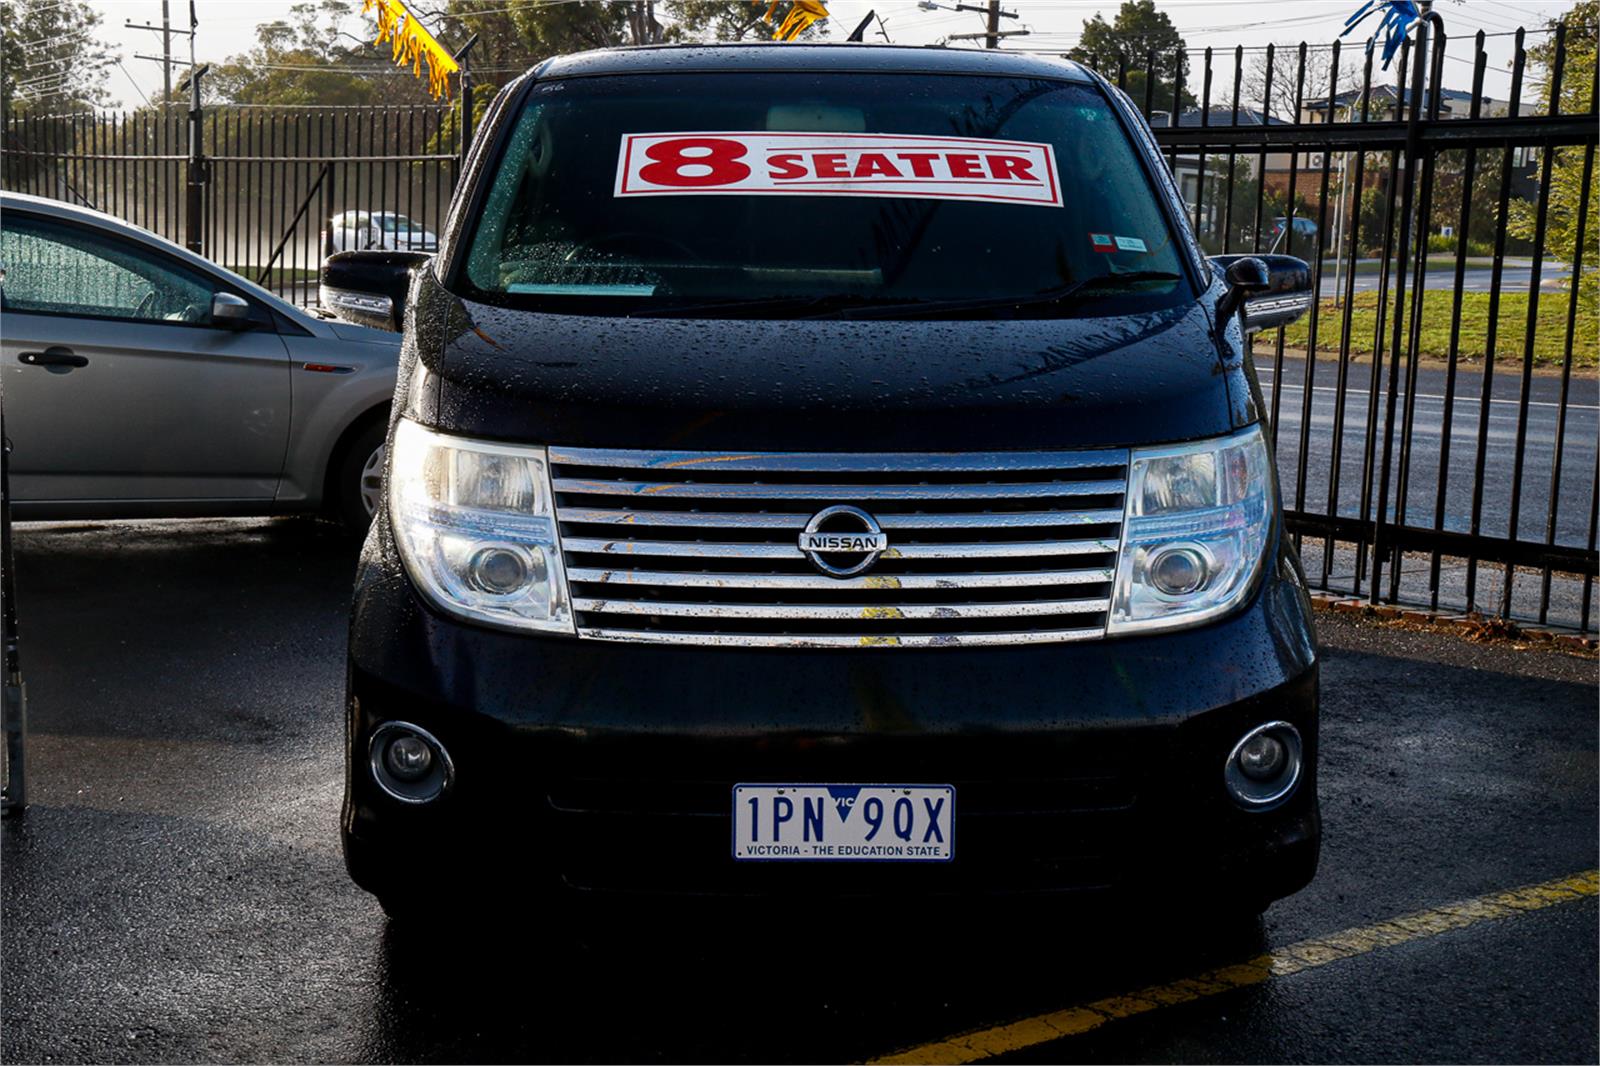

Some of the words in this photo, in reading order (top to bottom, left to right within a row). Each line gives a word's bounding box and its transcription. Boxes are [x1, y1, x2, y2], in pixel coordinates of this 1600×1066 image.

[639, 138, 751, 187] 8
[768, 153, 1040, 181] SEATER
[809, 537, 878, 548] NISSAN
[748, 797, 824, 842] 1PN
[863, 797, 945, 843] 9QX
[746, 845, 800, 855] VICTORIA
[812, 845, 834, 855] THE
[837, 845, 903, 855] EDUCATION
[907, 846, 940, 856] STATE
